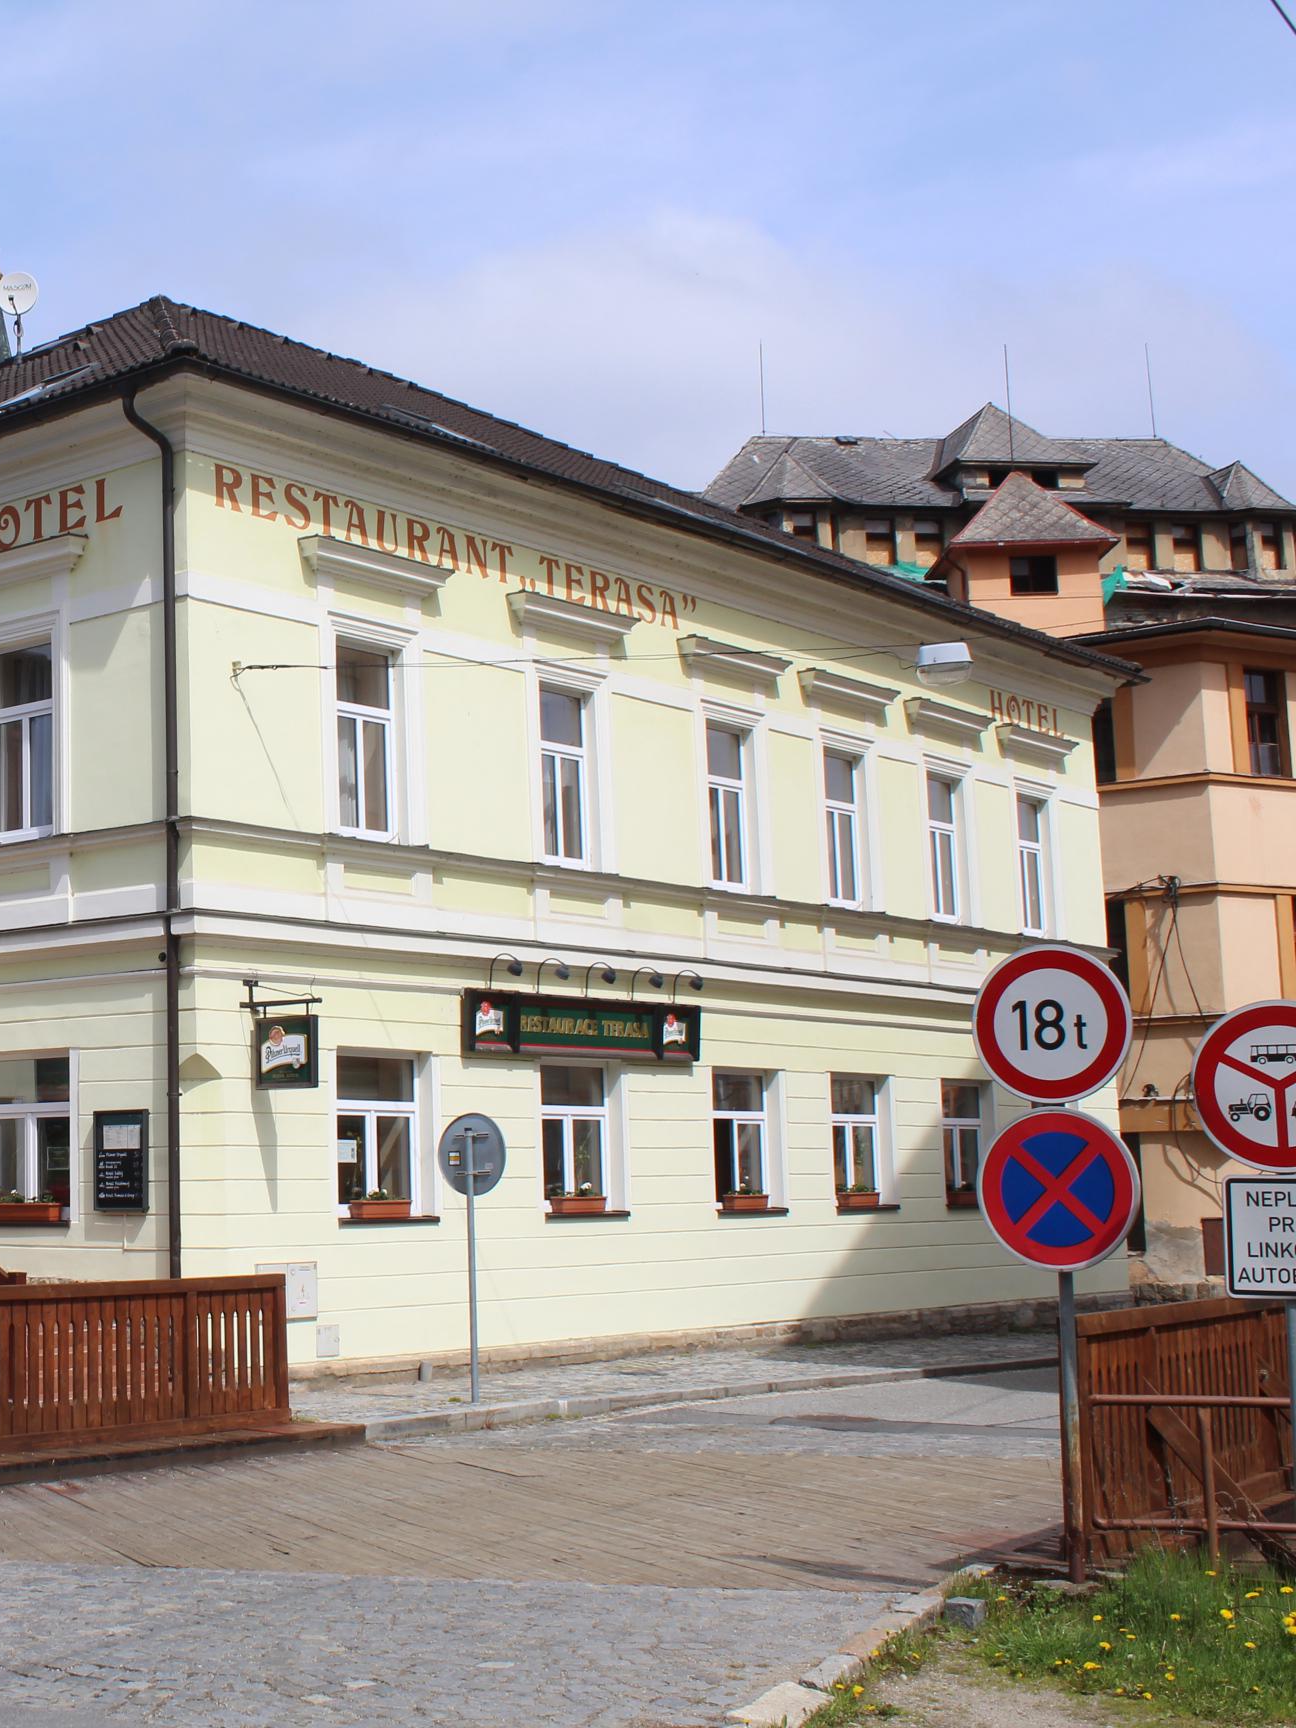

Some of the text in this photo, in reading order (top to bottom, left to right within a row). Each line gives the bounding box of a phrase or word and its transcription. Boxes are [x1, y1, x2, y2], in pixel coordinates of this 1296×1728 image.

[214, 463, 513, 585] RESTAURANT
[990, 688, 1065, 739] HOTEL
[519, 1015, 599, 1036] RESTAURACE
[602, 1020, 650, 1038] TERASA
[1011, 999, 1088, 1050] 18 t
[1247, 1242, 1296, 1258] LINK
[1238, 1267, 1296, 1284] AUTO
